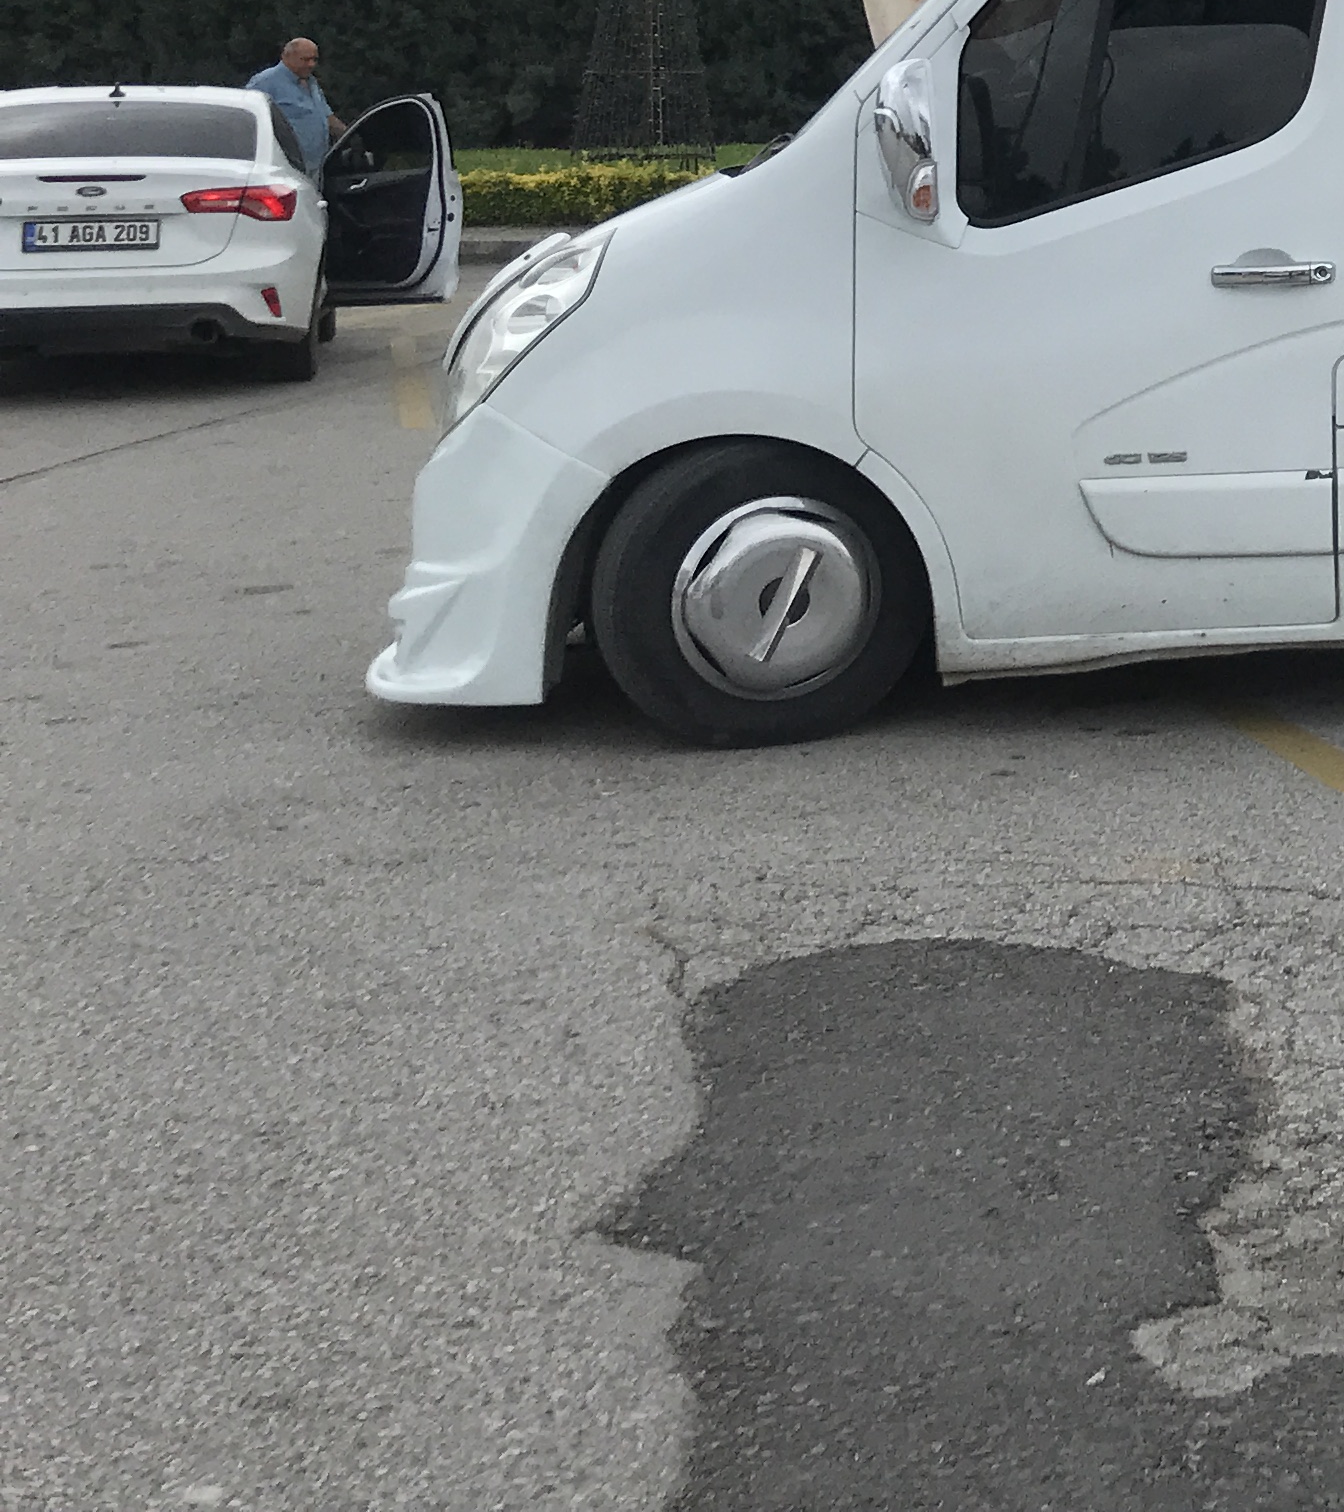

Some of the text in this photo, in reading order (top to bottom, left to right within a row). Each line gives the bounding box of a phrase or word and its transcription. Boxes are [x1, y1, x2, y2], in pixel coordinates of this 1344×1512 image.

[38, 224, 150, 243] 41 AGA 209
